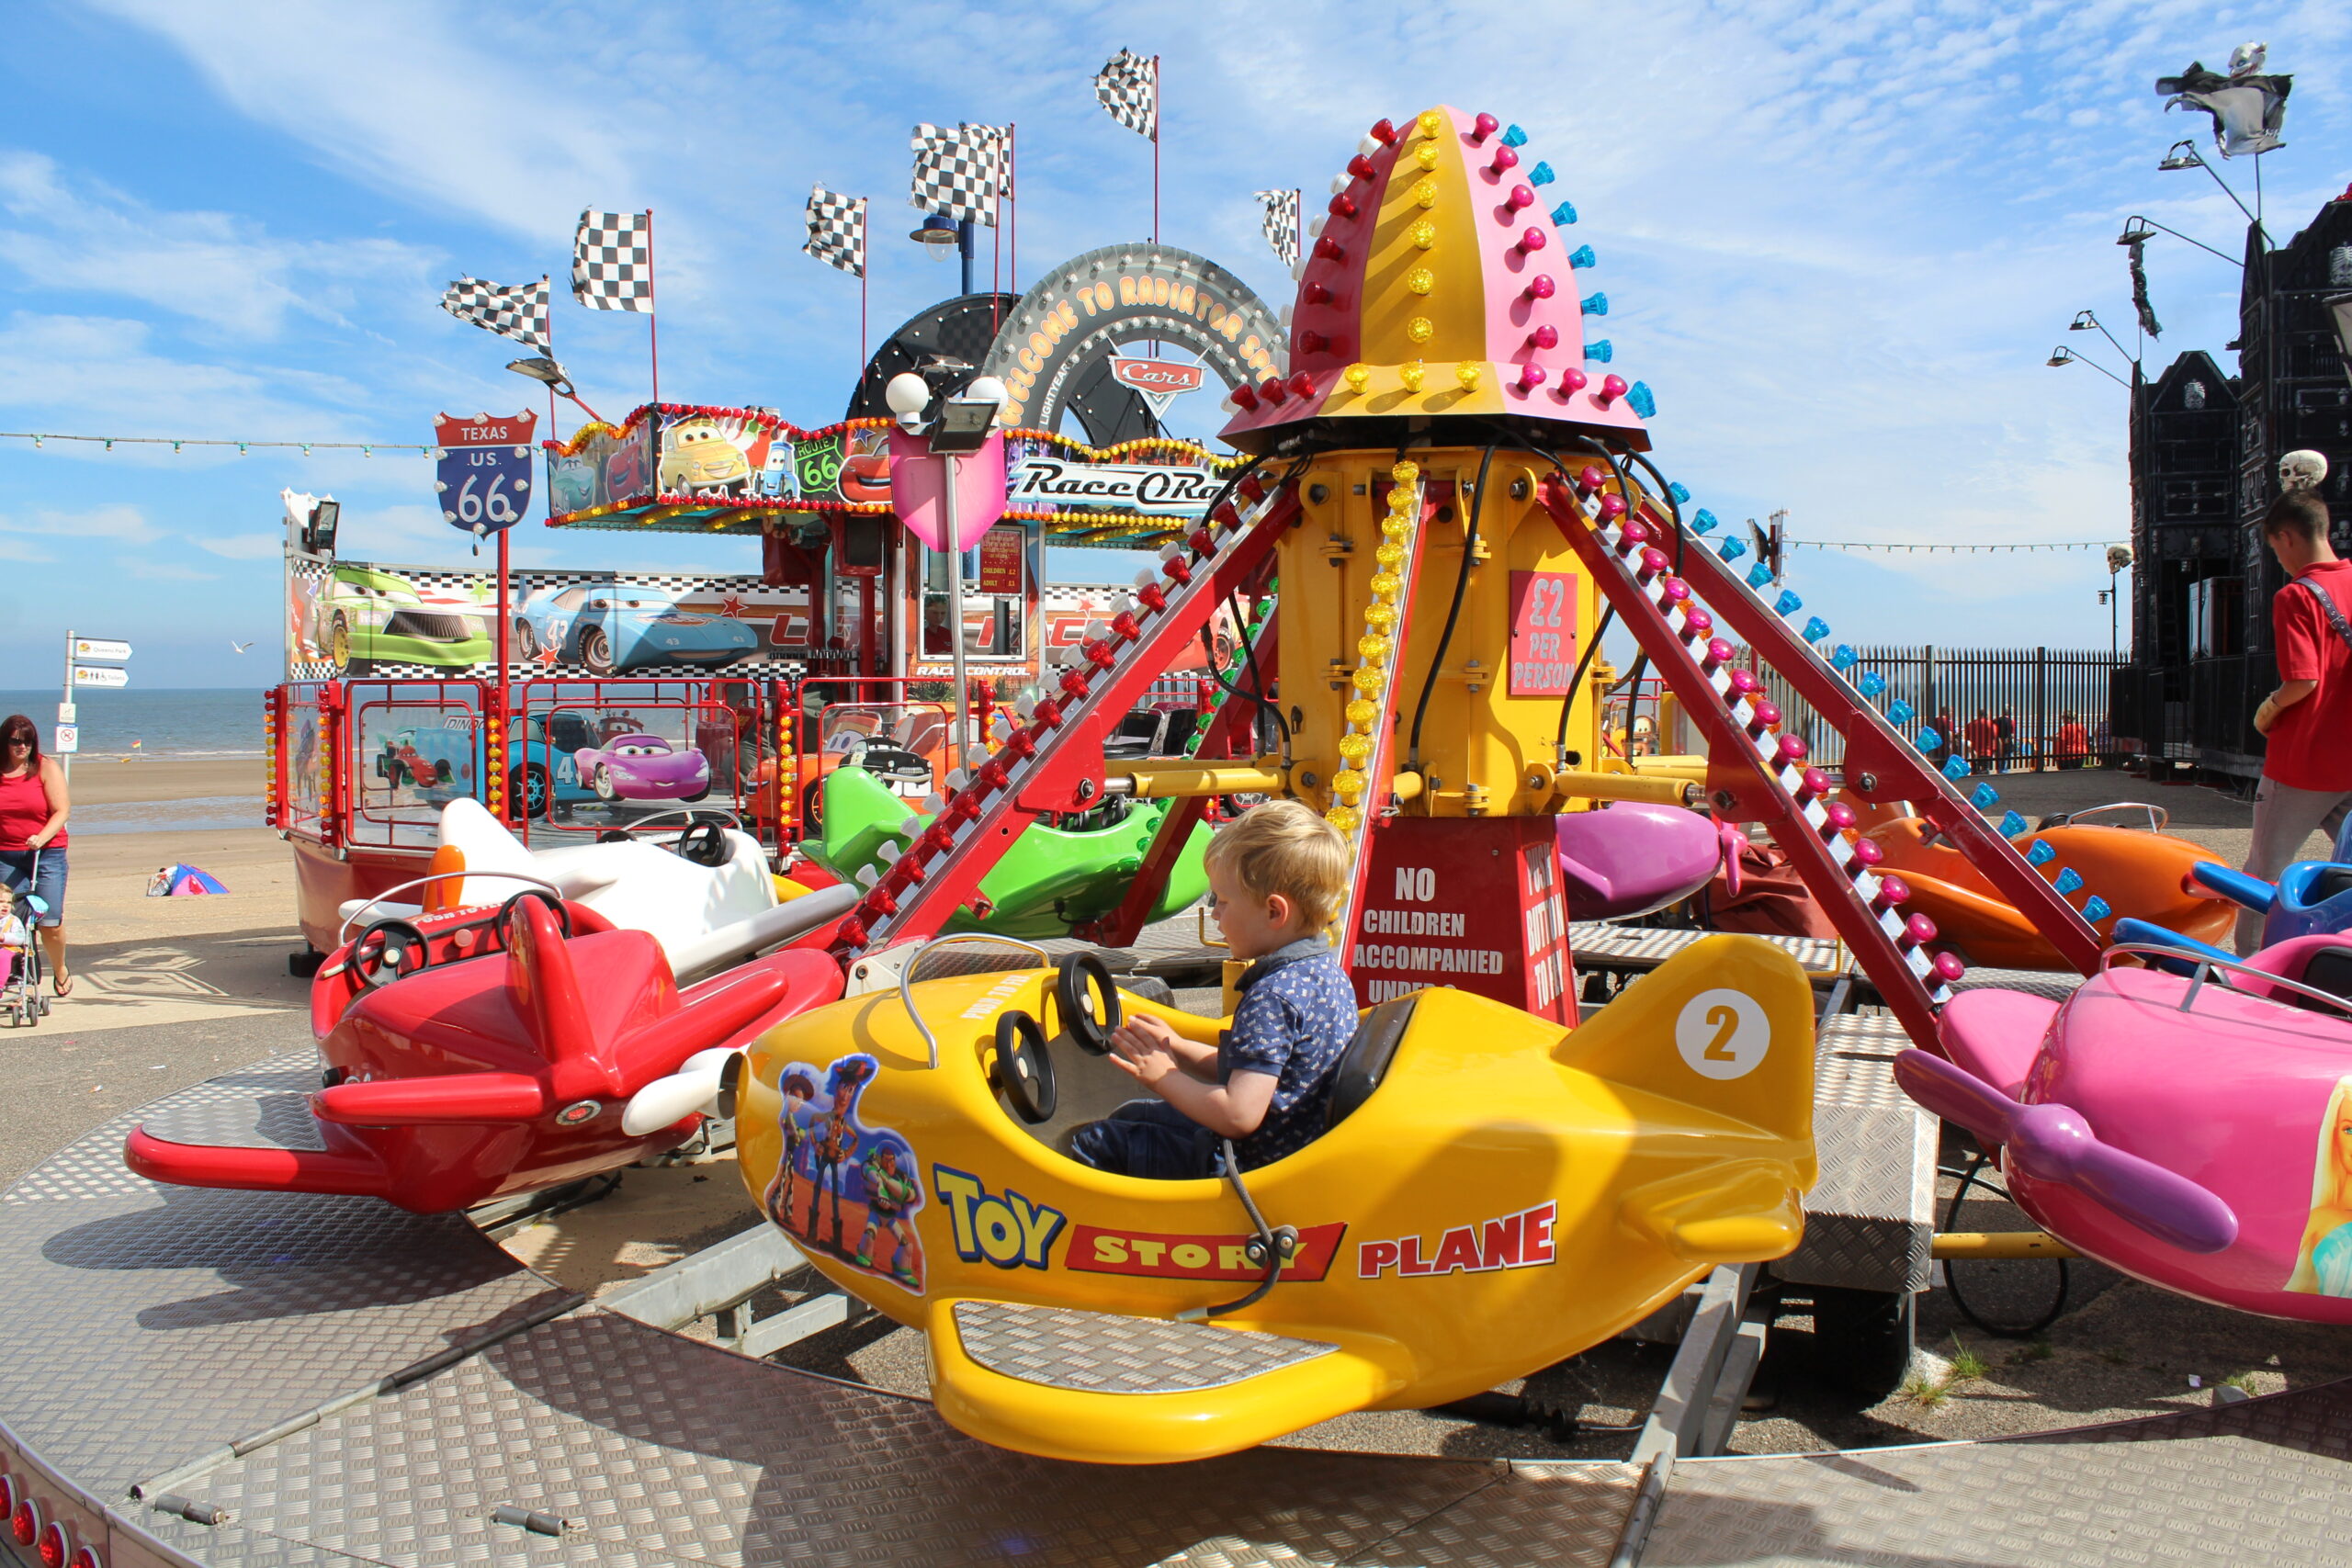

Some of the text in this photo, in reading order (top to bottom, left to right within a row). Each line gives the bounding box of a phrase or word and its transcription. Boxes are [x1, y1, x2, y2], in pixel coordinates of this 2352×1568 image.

[999, 299, 1079, 426] WELCOME
[1076, 281, 1114, 317] TO
[1119, 276, 1243, 343] RADIATOR
[1122, 364, 1193, 386] Cars
[1039, 362, 1070, 426] LIGHTYEAR
[461, 425, 508, 441] TEXAS
[797, 438, 830, 457] ROUTE
[470, 452, 497, 467] US
[804, 455, 839, 486] 66
[458, 473, 511, 523] 66
[1529, 578, 1565, 628] £2
[547, 619, 569, 650] 43
[1529, 632, 1560, 661] PER
[965, 666, 1030, 676] CONTROL
[1512, 662, 1575, 690] PERSON
[1395, 867, 1435, 901] NO
[1363, 909, 1465, 937] CHILDREN
[1526, 893, 1565, 957] BUTTON
[1534, 959, 1550, 1010] TO
[1704, 1005, 1739, 1061] 2
[933, 1162, 1067, 1269] TOY
[1358, 1200, 1557, 1279] PLANE
